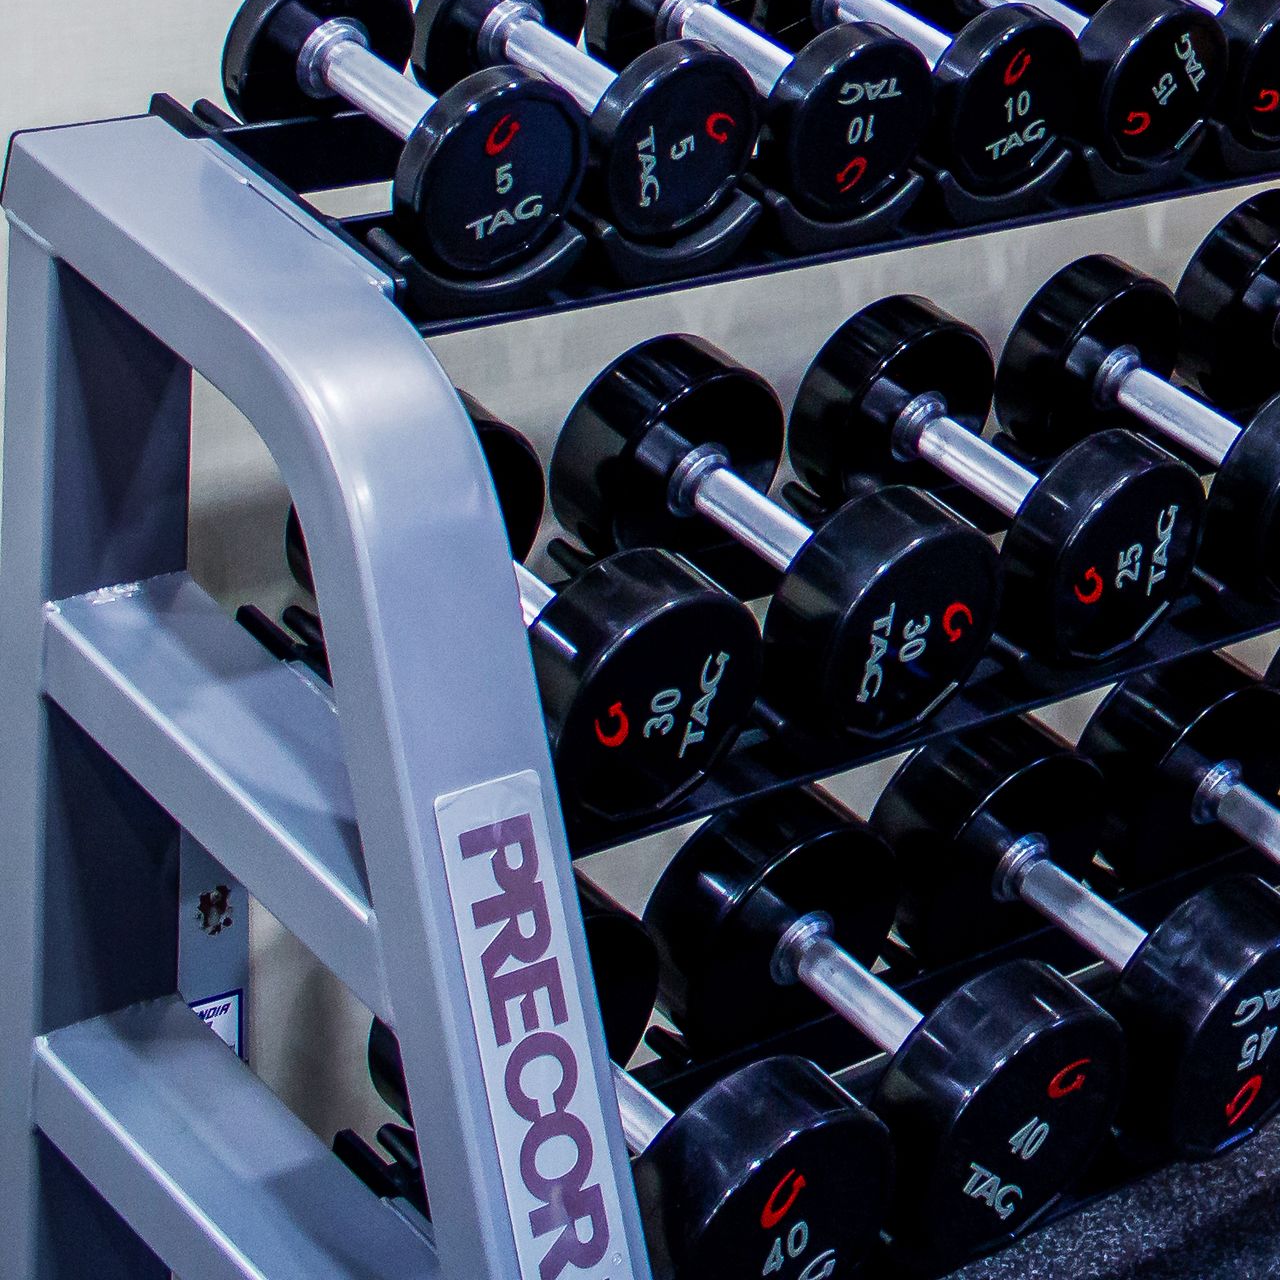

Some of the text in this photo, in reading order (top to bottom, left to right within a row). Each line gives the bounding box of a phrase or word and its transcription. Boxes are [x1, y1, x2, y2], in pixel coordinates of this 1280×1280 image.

[1175, 33, 1204, 91] TAG
[836, 77, 902, 106] TAG
[1003, 90, 1031, 123] 10
[1152, 72, 1177, 105] 15
[670, 134, 695, 161] 5
[847, 114, 876, 145] 10
[985, 118, 1047, 161] TAG
[494, 164, 513, 194] 5
[636, 125, 662, 209] TAG
[465, 195, 544, 241] TAG
[1114, 542, 1143, 590] 25
[1145, 504, 1180, 596] TAG
[856, 602, 897, 704] TAG
[898, 613, 931, 663] 30
[642, 687, 684, 737] 30
[677, 652, 730, 758] TAG
[457, 813, 609, 1280] PRECOR
[1237, 1026, 1279, 1071] 45
[1007, 1116, 1050, 1161] 40
[961, 1162, 1024, 1221] TAG
[761, 1221, 810, 1278] 40
